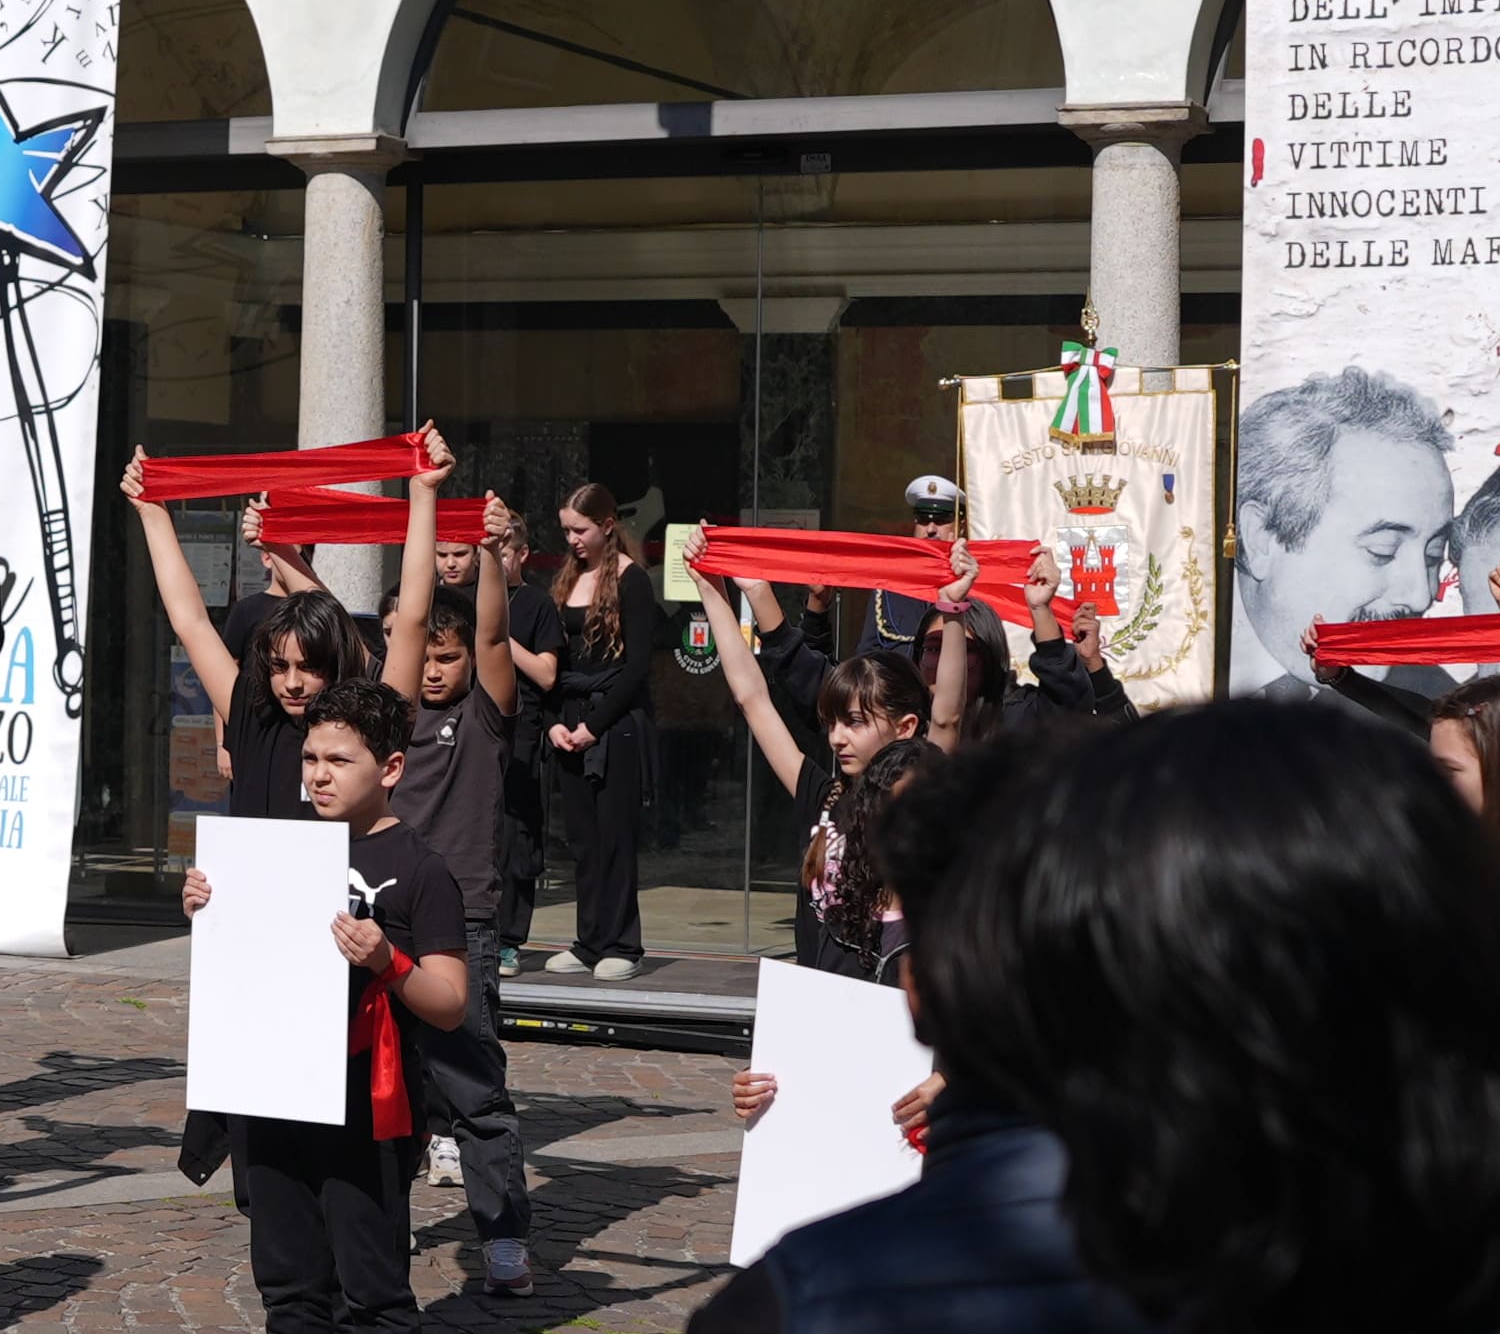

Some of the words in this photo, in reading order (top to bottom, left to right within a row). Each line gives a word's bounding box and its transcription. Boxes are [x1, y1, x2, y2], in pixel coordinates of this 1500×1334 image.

[1288, 43, 1328, 71] IN
[1288, 90, 1412, 121] DELLE
[1287, 138, 1448, 170] VITTIME
[1285, 187, 1487, 219] INNOCENTI
[1284, 239, 1409, 268] DELLE
[1000, 444, 1055, 475] SESTO
[1099, 441, 1181, 468] GIOVANNI
